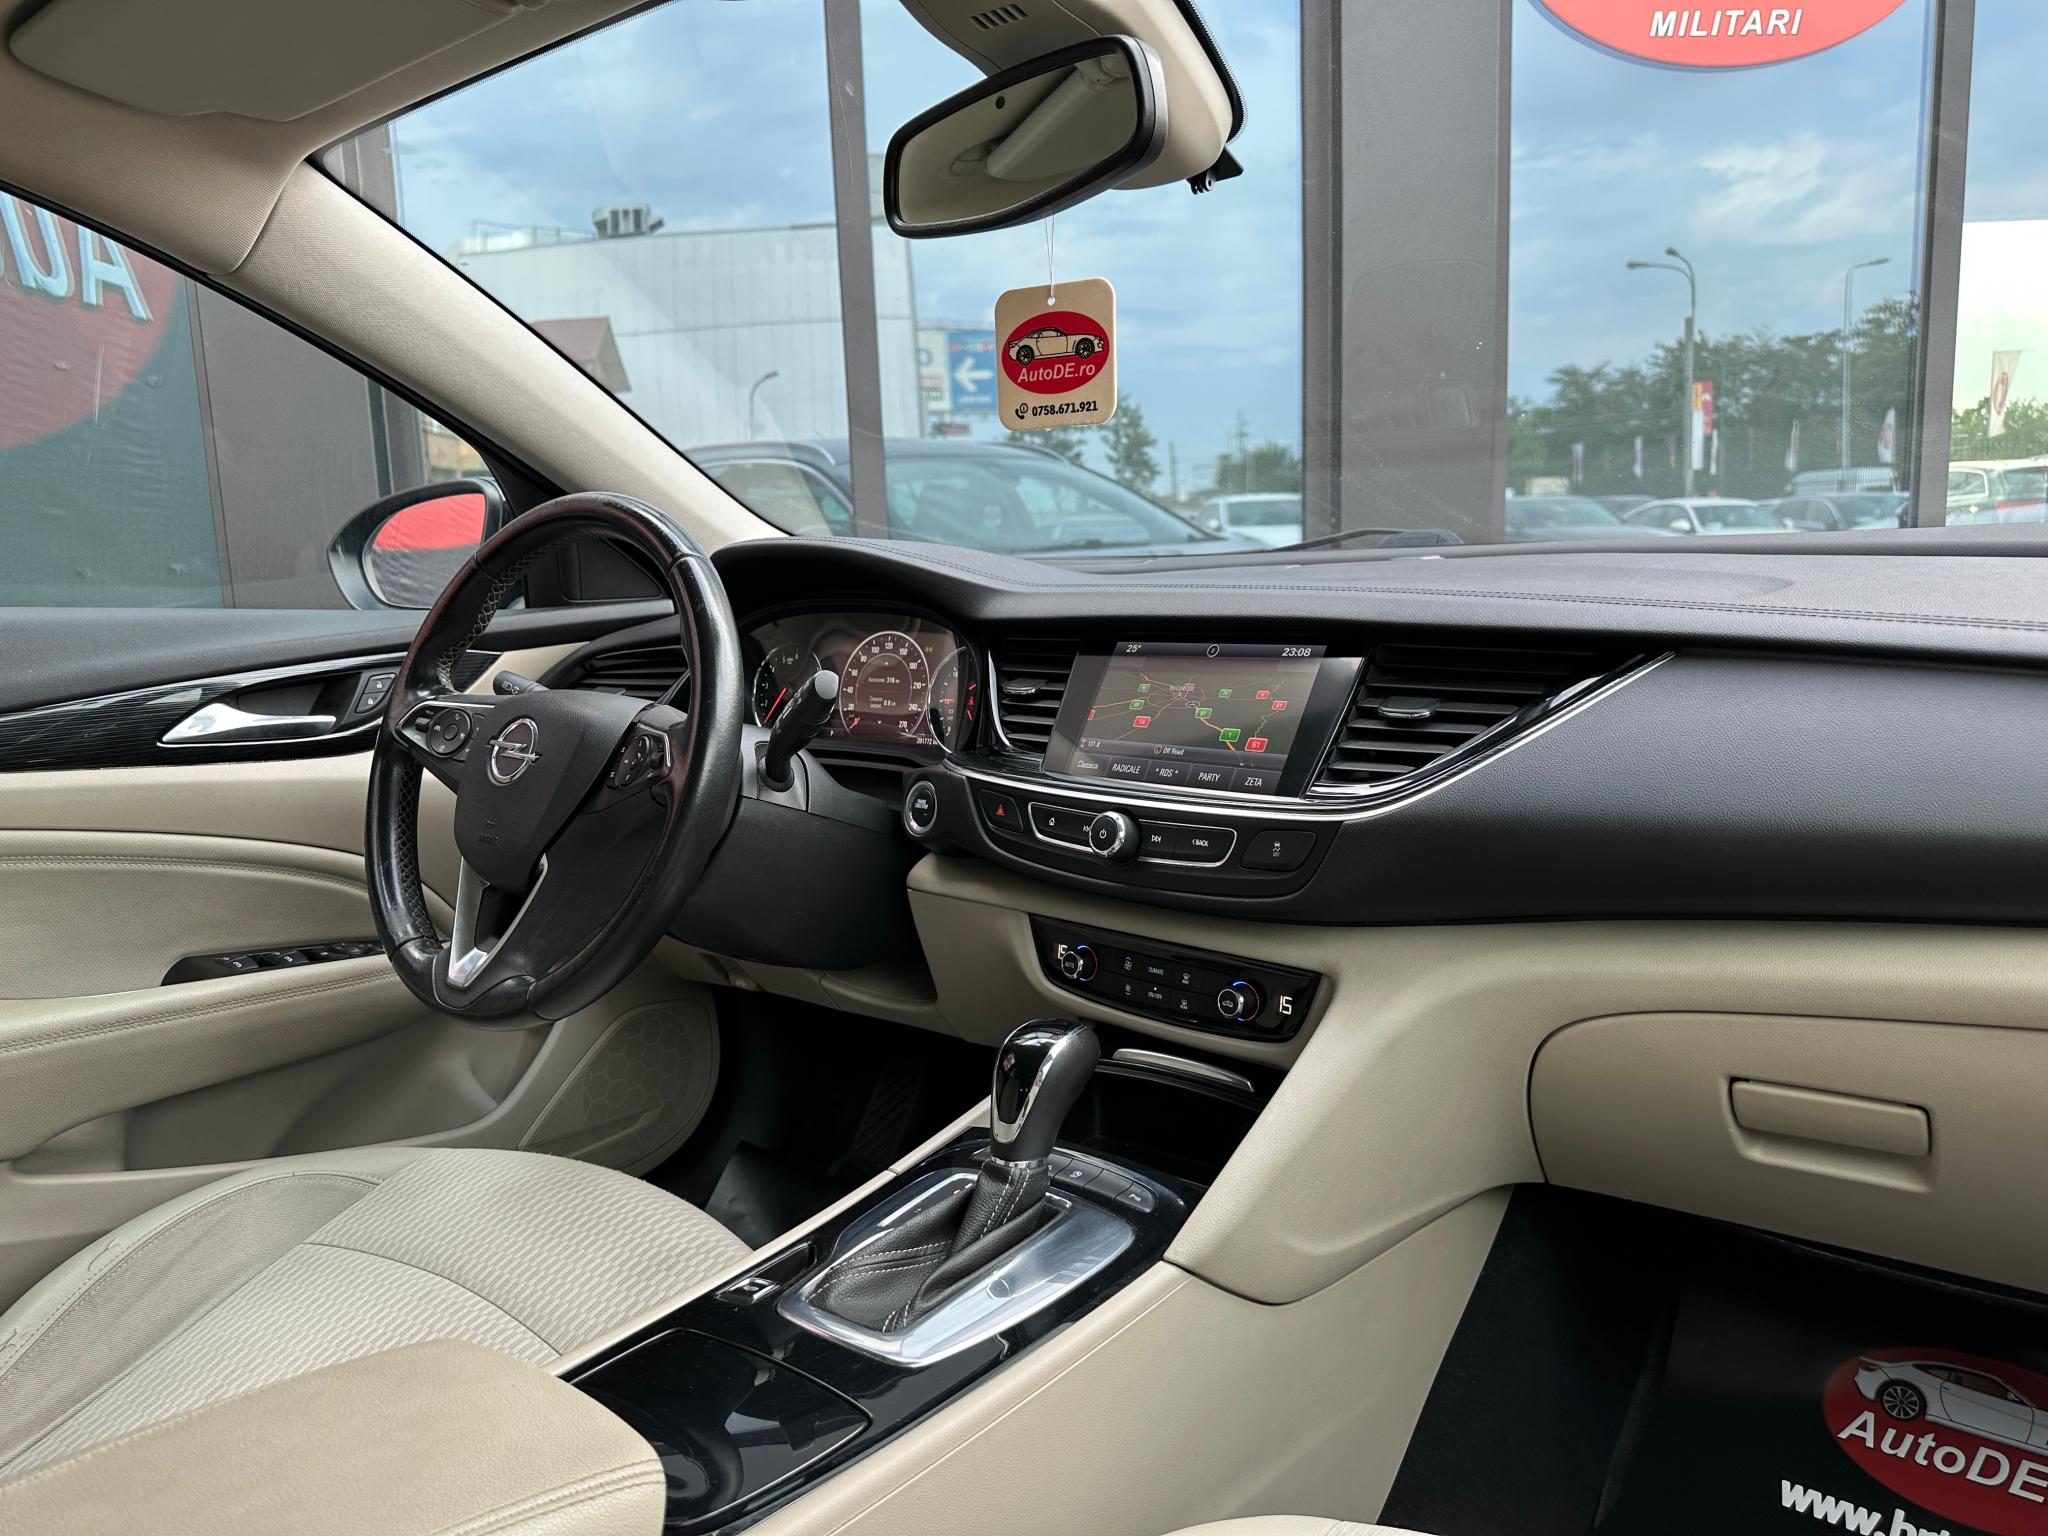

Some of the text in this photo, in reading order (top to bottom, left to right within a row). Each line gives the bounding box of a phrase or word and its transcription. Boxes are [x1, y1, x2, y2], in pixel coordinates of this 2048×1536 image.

[1649, 8, 1803, 37] MILITARI
[1017, 363, 1096, 382] AutoDE.ro
[1032, 401, 1098, 416] 0758.671.921
[1281, 647, 1312, 657] 23:08
[1112, 763, 1141, 774] RADICALE
[1198, 772, 1221, 782] PARTY
[1245, 777, 1263, 787] ZETA
[1279, 995, 1293, 1015] 15
